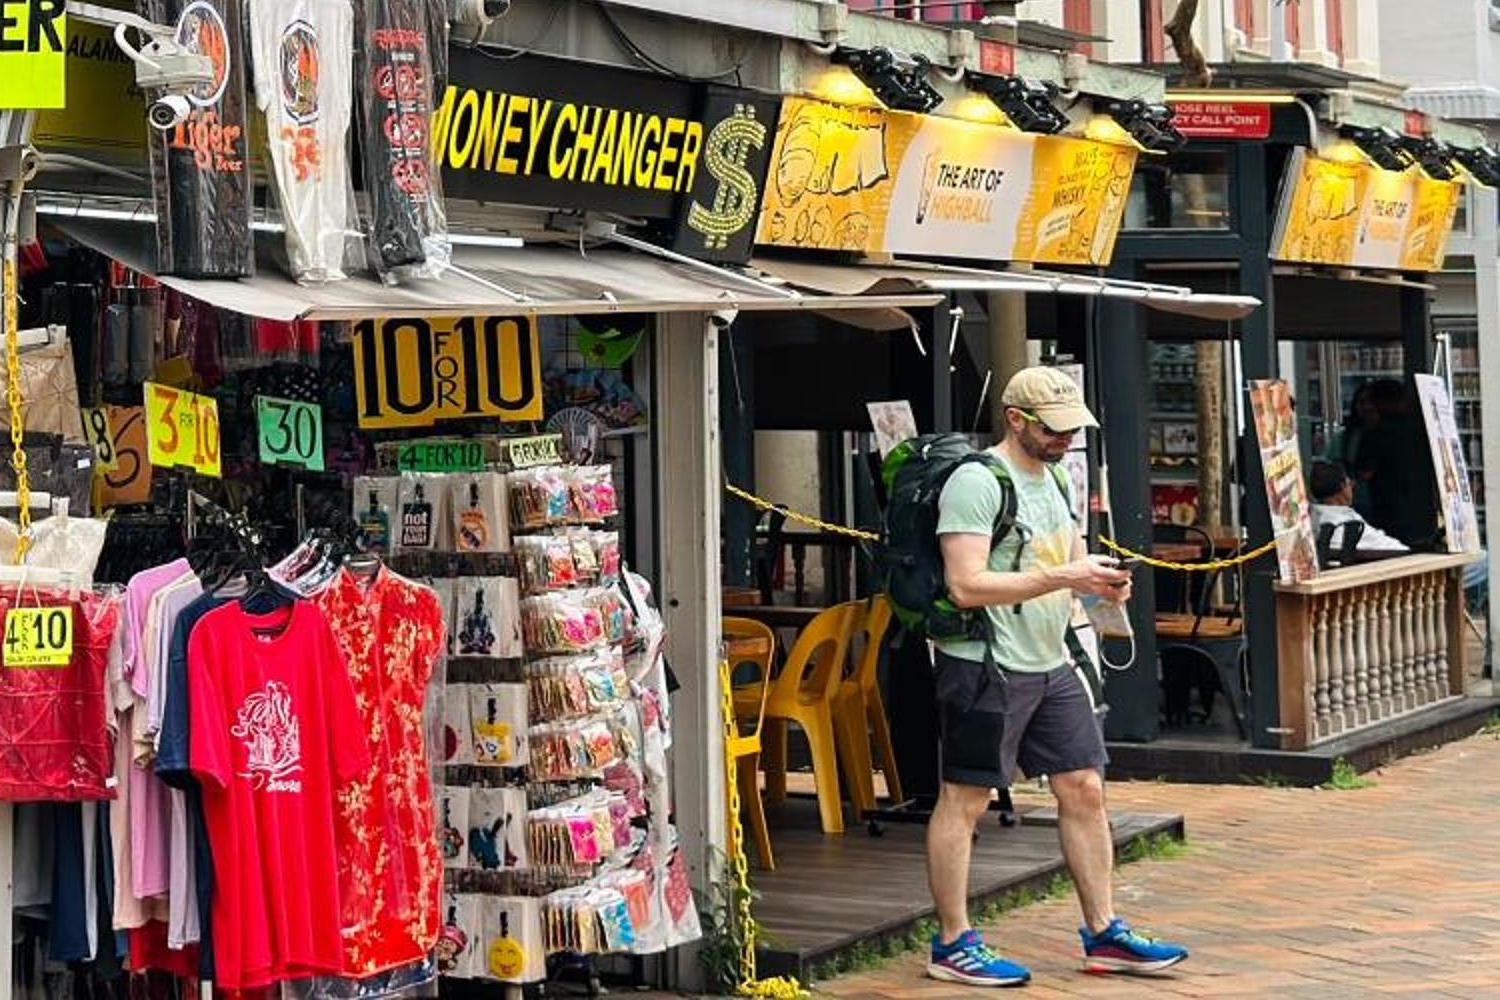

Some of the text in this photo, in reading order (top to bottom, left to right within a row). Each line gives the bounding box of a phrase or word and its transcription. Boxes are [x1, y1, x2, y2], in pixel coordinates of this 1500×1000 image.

[1192, 115, 1222, 125] CALL
[1225, 115, 1261, 125] POINT
[1205, 103, 1236, 113] REEL
[548, 103, 703, 192] CHANGER
[937, 164, 1004, 192] THE ART OF
[354, 315, 534, 417] 10 FOR 10
[154, 386, 179, 453] 3
[190, 394, 219, 465] 10
[265, 401, 317, 459] 30
[400, 444, 424, 469] 4
[460, 443, 482, 467] 10
[404, 511, 427, 525] not
[6, 613, 19, 653] 4
[33, 609, 67, 650] 10
